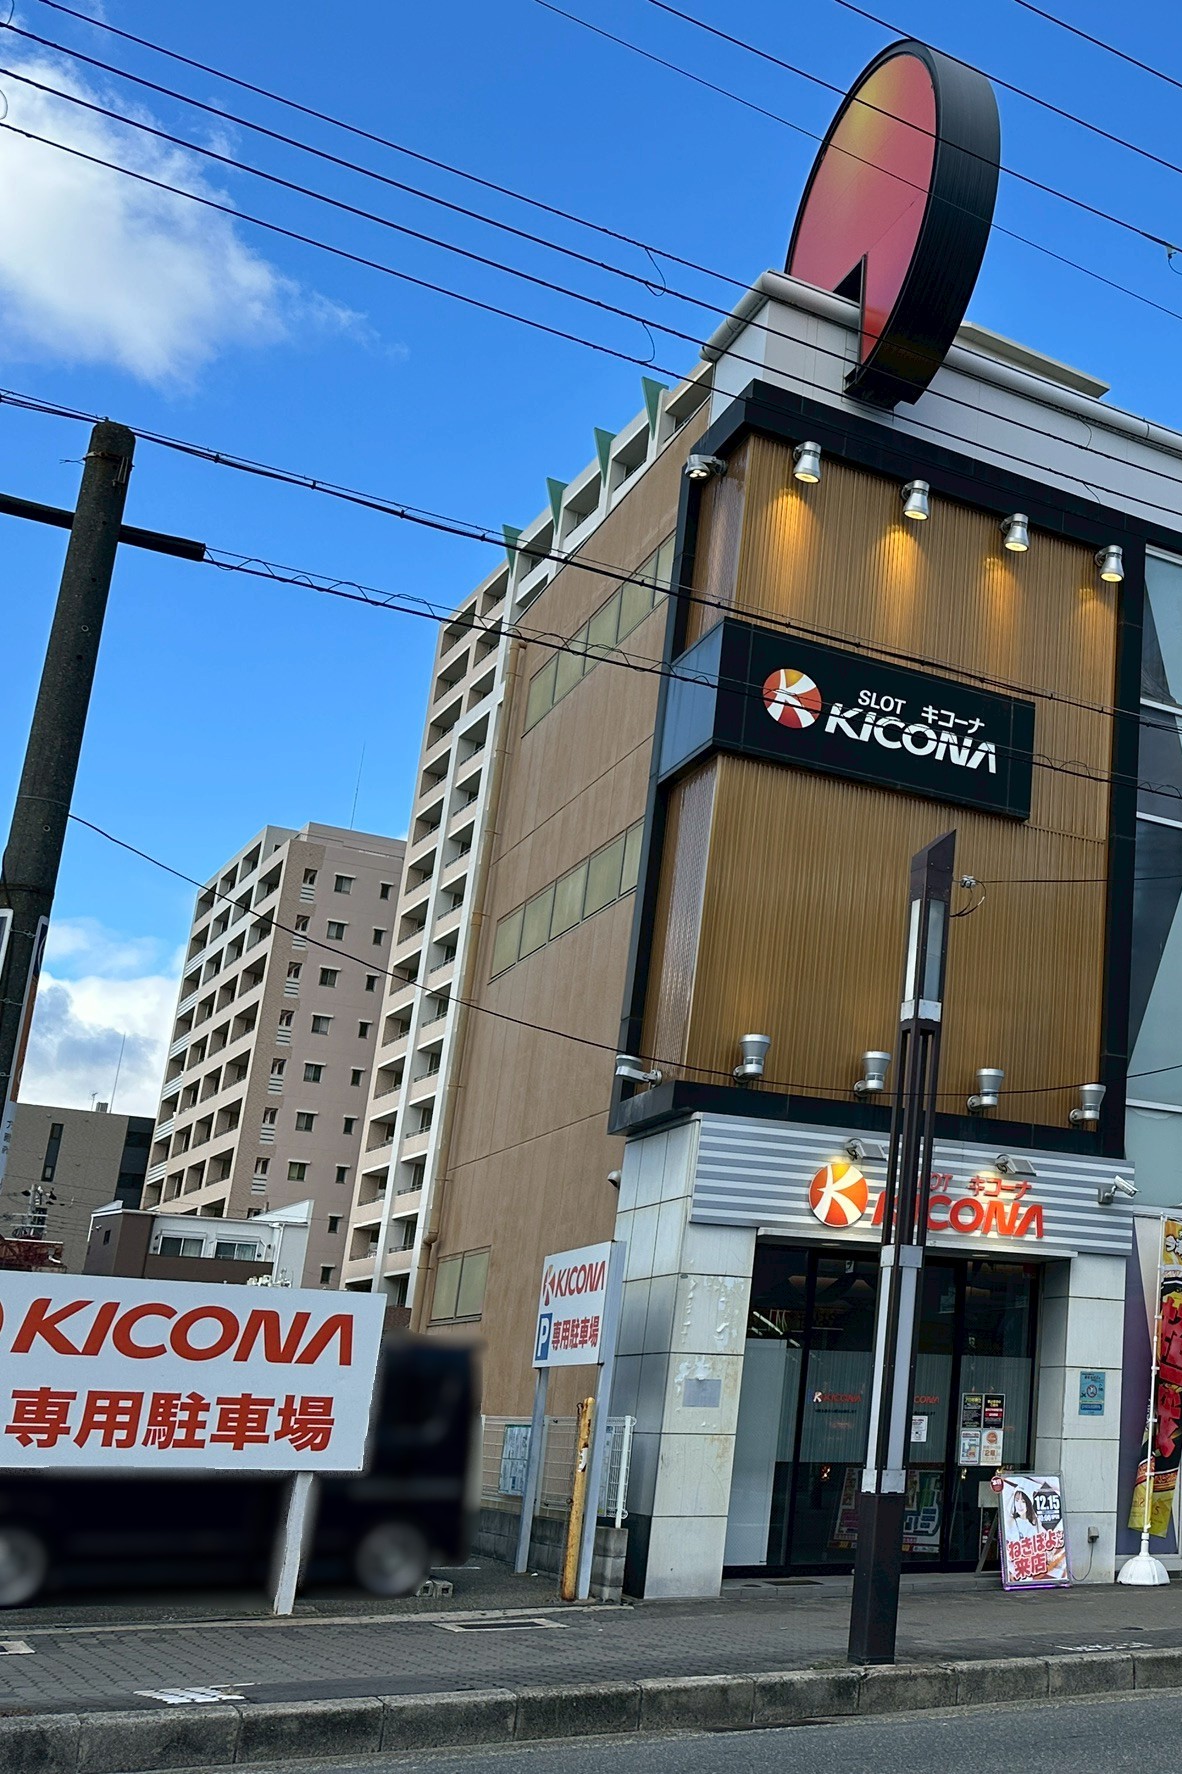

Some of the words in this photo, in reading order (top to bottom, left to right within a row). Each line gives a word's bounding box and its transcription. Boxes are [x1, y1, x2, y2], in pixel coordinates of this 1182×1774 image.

[857, 689, 906, 715] SLOT
[921, 704, 985, 734] キコーナ
[824, 702, 996, 774] KICONA
[968, 1175, 1032, 1200] キコーナ
[870, 1190, 1044, 1239] KCONA
[555, 1261, 606, 1298] KICONA
[11, 1297, 353, 1366] KICONA
[537, 1317, 550, 1357] P
[551, 1315, 600, 1351] 専用駐車場
[4, 1386, 335, 1452] 専用駐車場
[914, 1395, 940, 1404] CONA
[1034, 1494, 1060, 1511] 12.15
[1013, 1553, 1048, 1579] 来店
